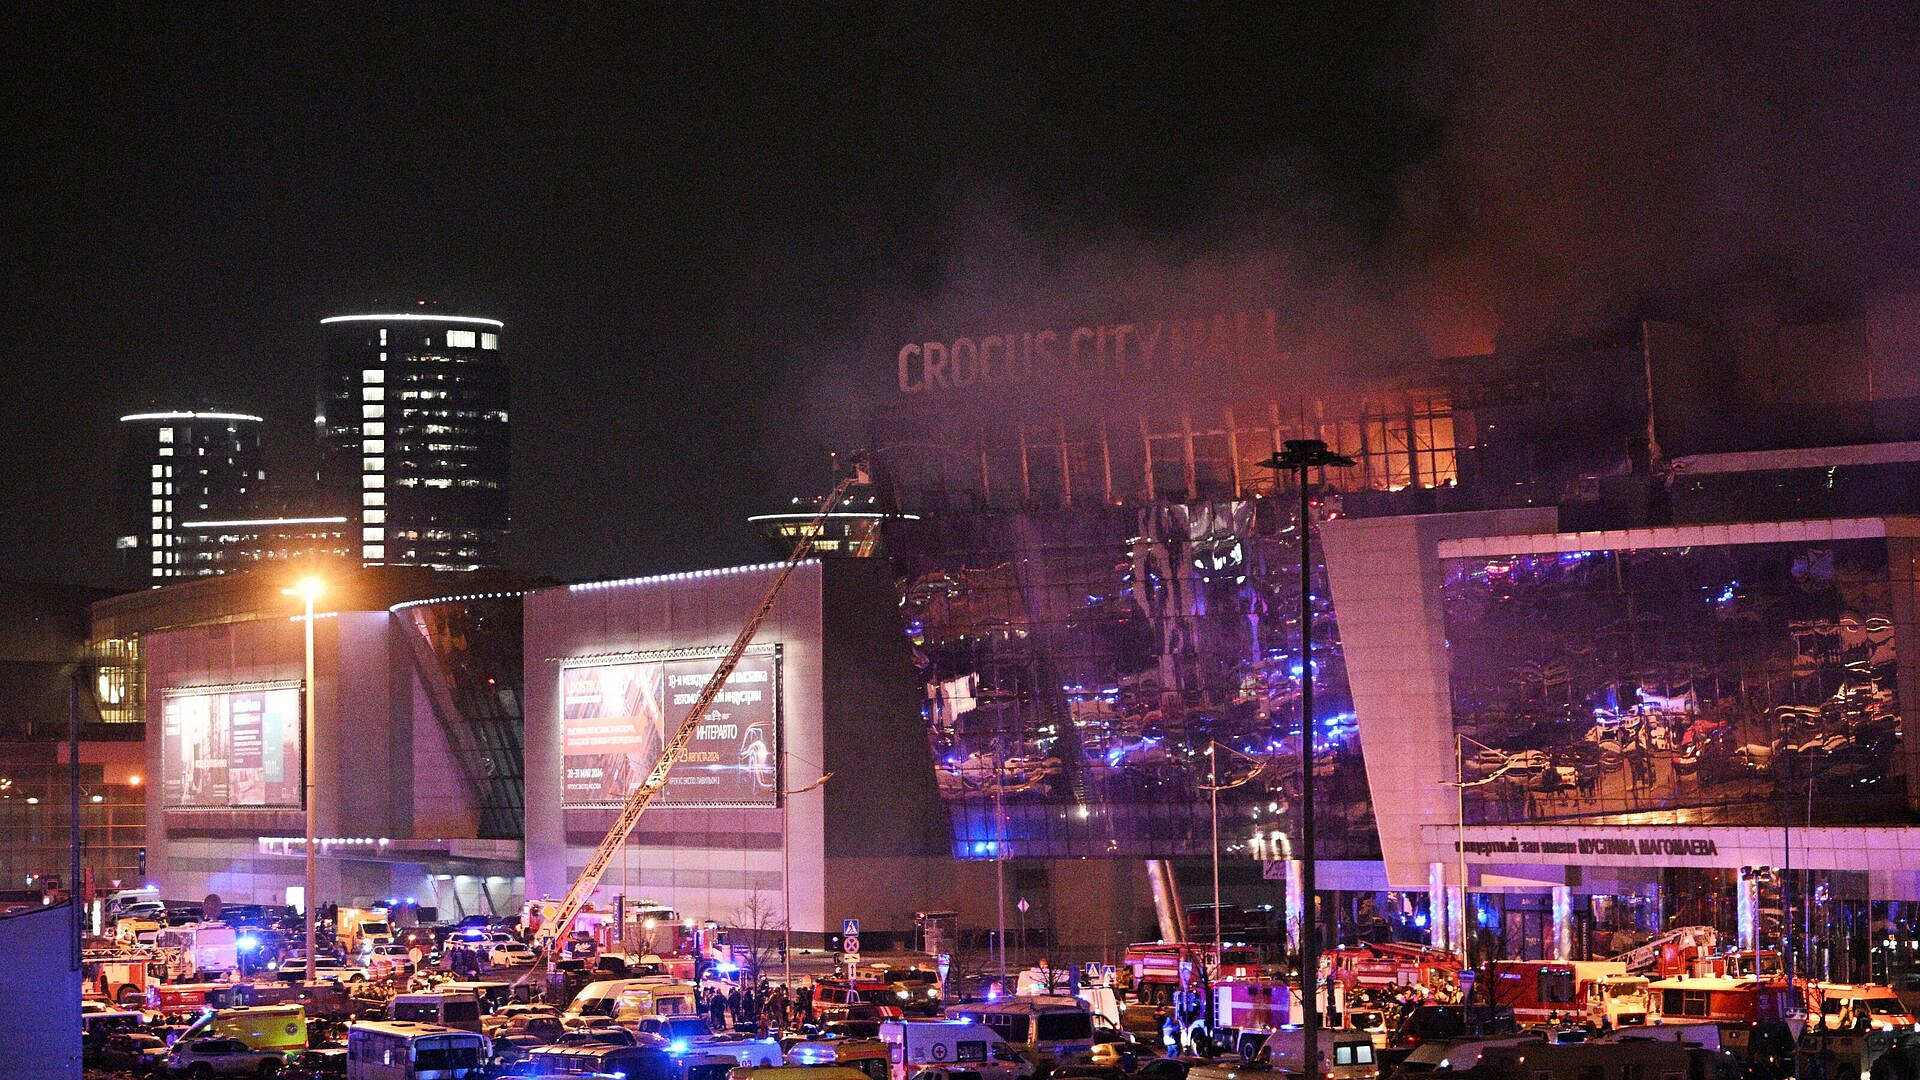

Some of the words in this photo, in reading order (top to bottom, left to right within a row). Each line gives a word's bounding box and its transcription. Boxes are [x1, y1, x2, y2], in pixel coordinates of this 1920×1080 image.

[897, 331, 1059, 393] CROCUS
[1067, 321, 1163, 374] CITY
[696, 724, 738, 740] ИНТЕРАВТО
[1520, 841, 1540, 853] зал
